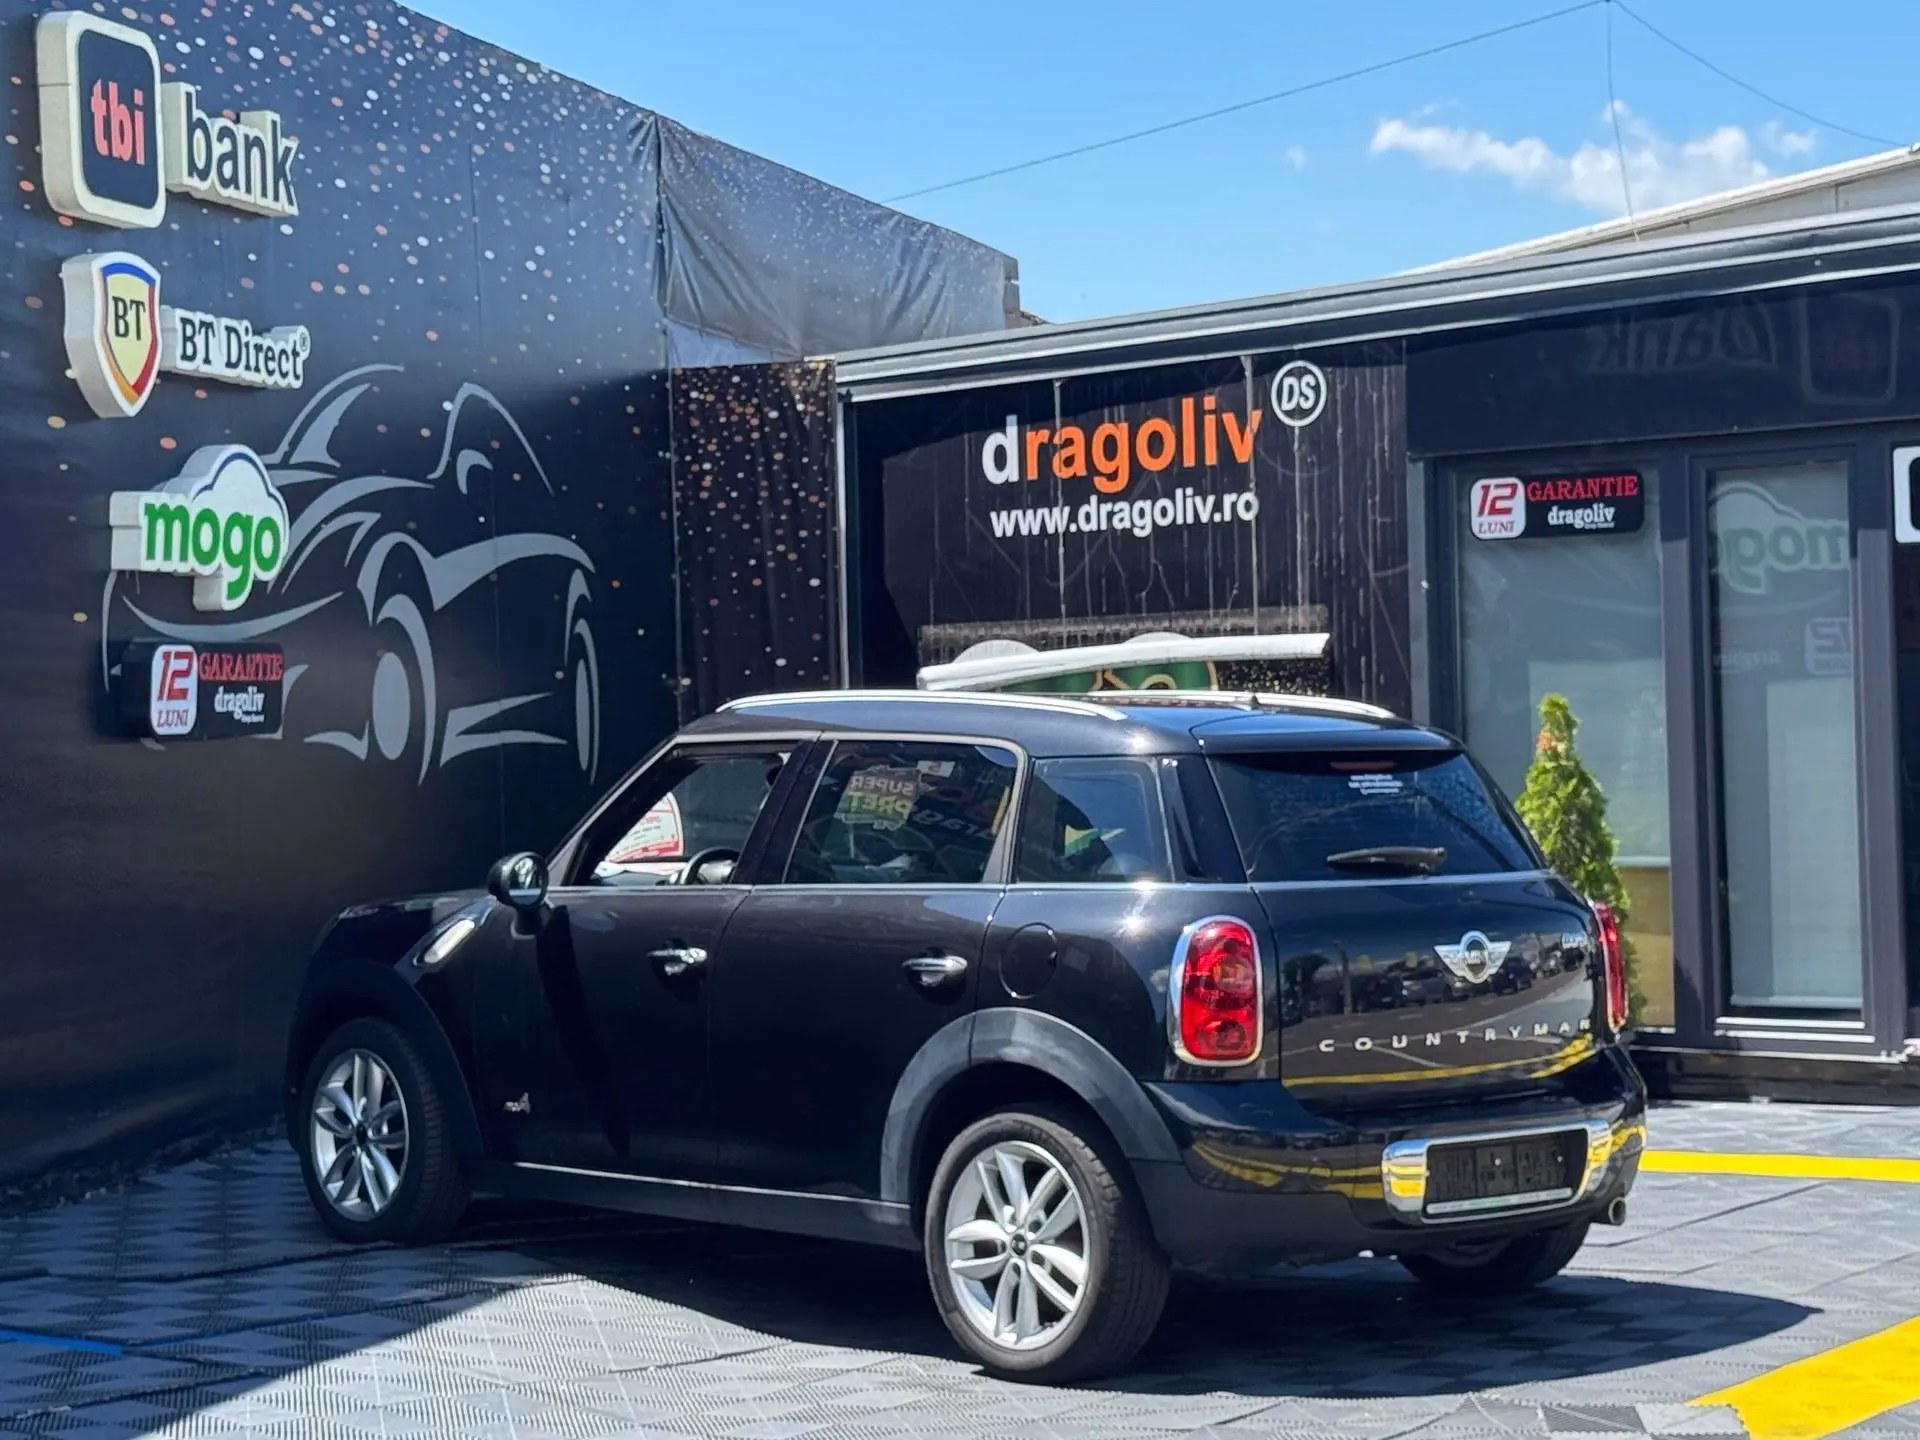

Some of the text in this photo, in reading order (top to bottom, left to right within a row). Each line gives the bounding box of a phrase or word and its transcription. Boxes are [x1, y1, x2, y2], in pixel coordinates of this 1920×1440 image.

[91, 79, 299, 207] tbi bank
[112, 296, 146, 341] BT
[179, 316, 216, 366] BT
[1280, 371, 1316, 413] DS
[981, 395, 1263, 493] dragoliv
[1476, 482, 1519, 518] 12
[1526, 475, 1640, 502] GARANTIE
[990, 487, 1260, 538] www.dragoliv.ro
[1478, 521, 1516, 535] LUNI
[1547, 502, 1617, 529] dragoliv
[144, 502, 281, 601] mogo
[157, 651, 194, 702] 12
[198, 652, 283, 681] GARANTIE
[156, 708, 190, 728] LUNI
[214, 685, 265, 720] dragoliv
[1318, 1018, 1592, 1052] COUNTRYMAN
